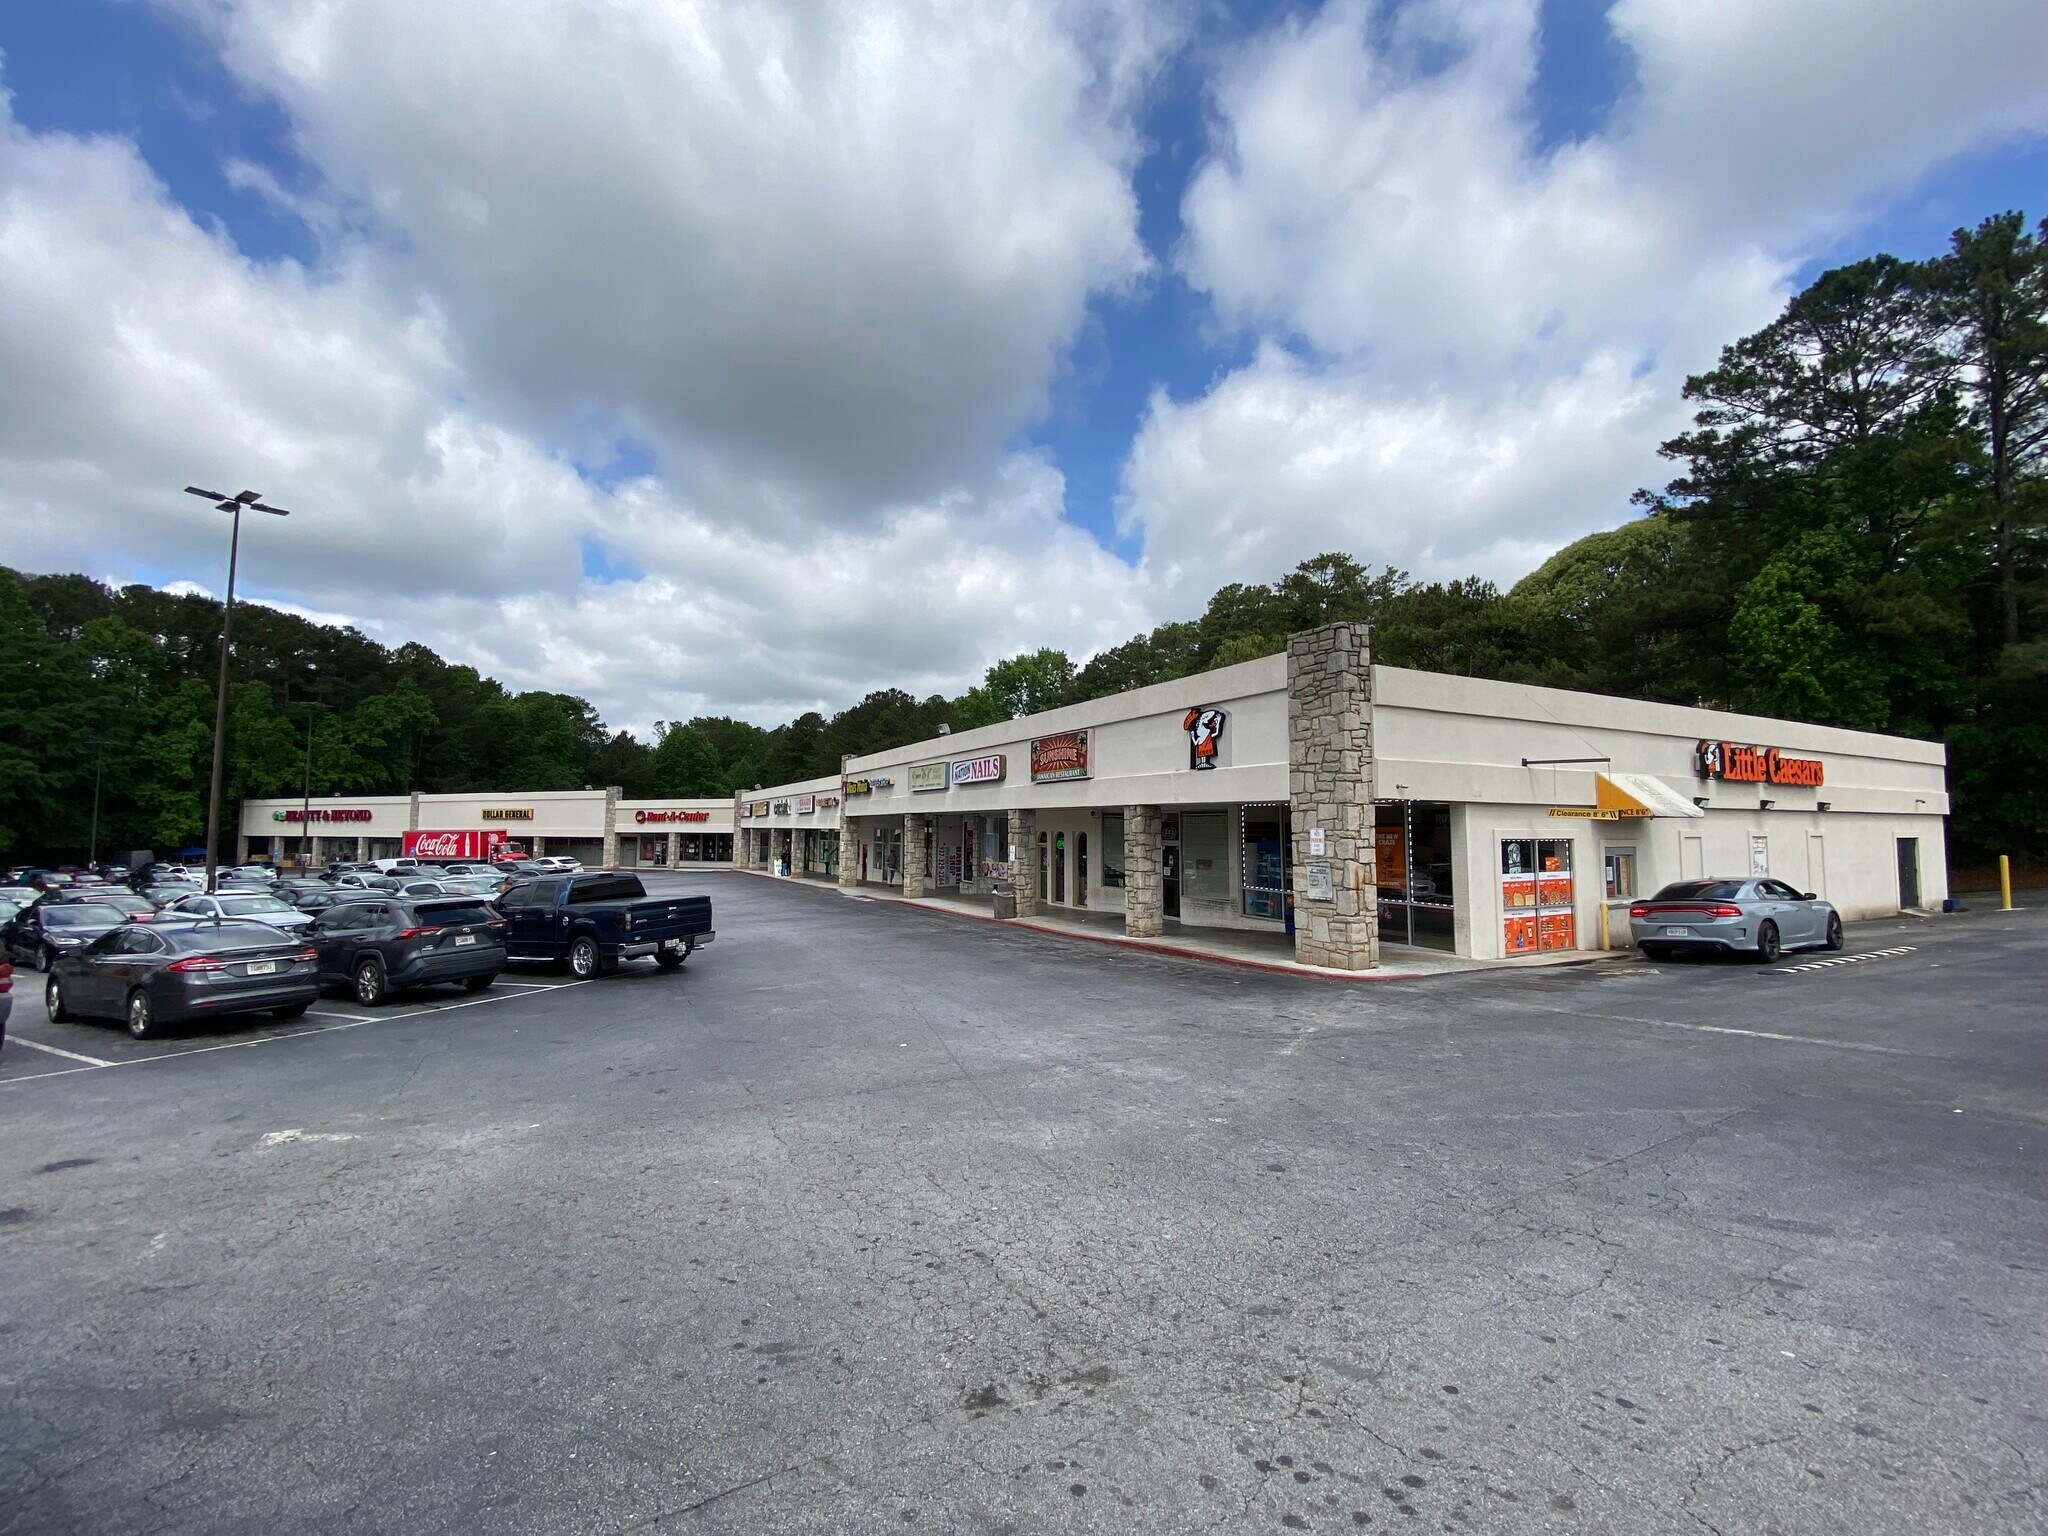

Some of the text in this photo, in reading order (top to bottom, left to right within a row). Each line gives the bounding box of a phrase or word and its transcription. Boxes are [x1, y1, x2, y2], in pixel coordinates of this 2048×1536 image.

[1040, 748, 1078, 766] SUNSHINE
[971, 758, 999, 780] NAILS
[1721, 743, 1823, 786] Little Caesars
[322, 810, 331, 821] &
[482, 808, 530, 819] DOLLAR GENERAL
[1556, 810, 1591, 818] Clearance
